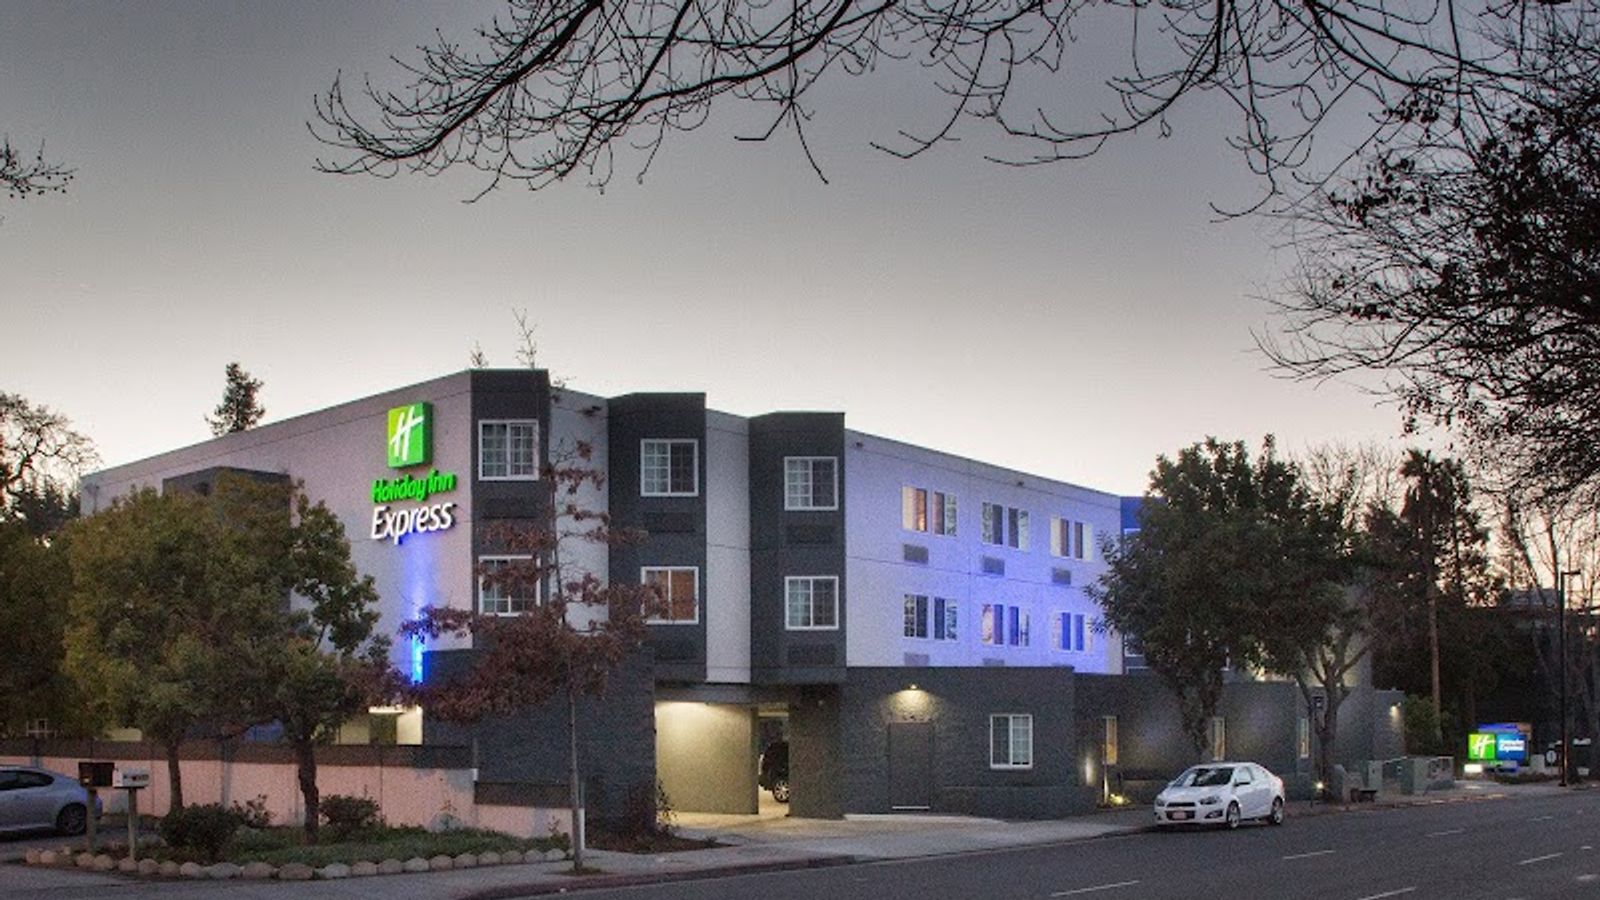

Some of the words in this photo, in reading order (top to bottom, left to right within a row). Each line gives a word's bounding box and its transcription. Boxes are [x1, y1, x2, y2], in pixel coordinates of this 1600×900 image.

[371, 474, 426, 503] Holiday
[427, 469, 456, 494] Inn
[371, 501, 454, 545] Express
